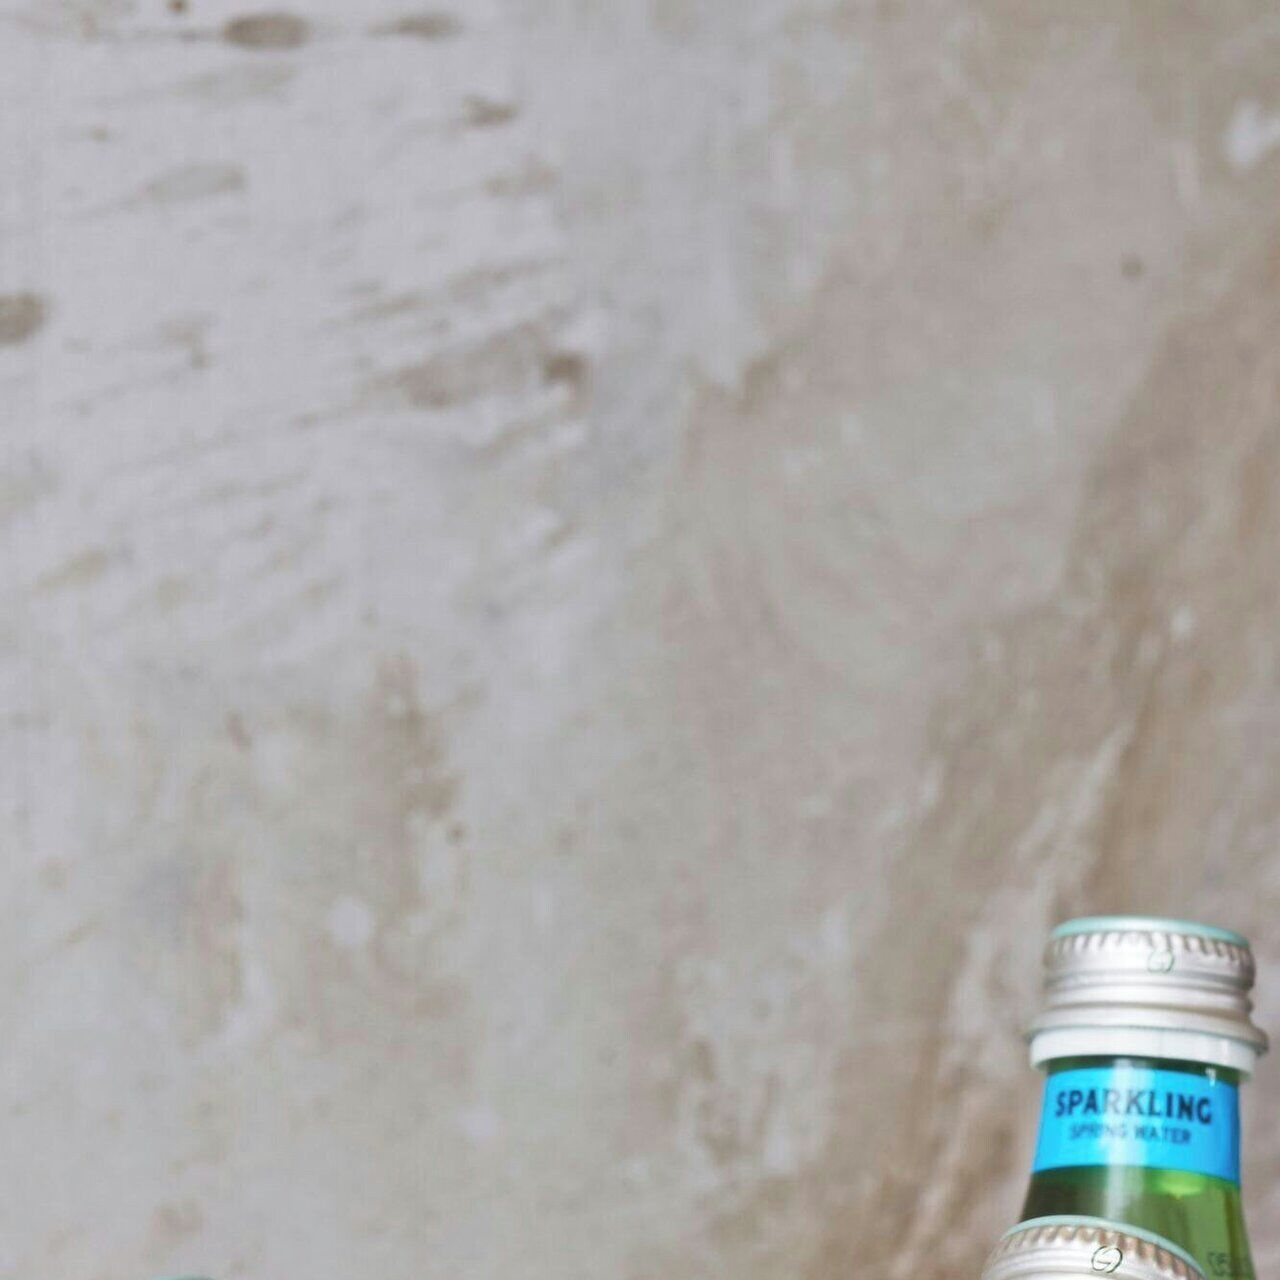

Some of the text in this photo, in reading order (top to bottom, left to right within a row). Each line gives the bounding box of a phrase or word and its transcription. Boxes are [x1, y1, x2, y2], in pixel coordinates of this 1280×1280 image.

[1054, 1087, 1213, 1125] SPARKLING
[1069, 1123, 1191, 1145] SPRING WATER
